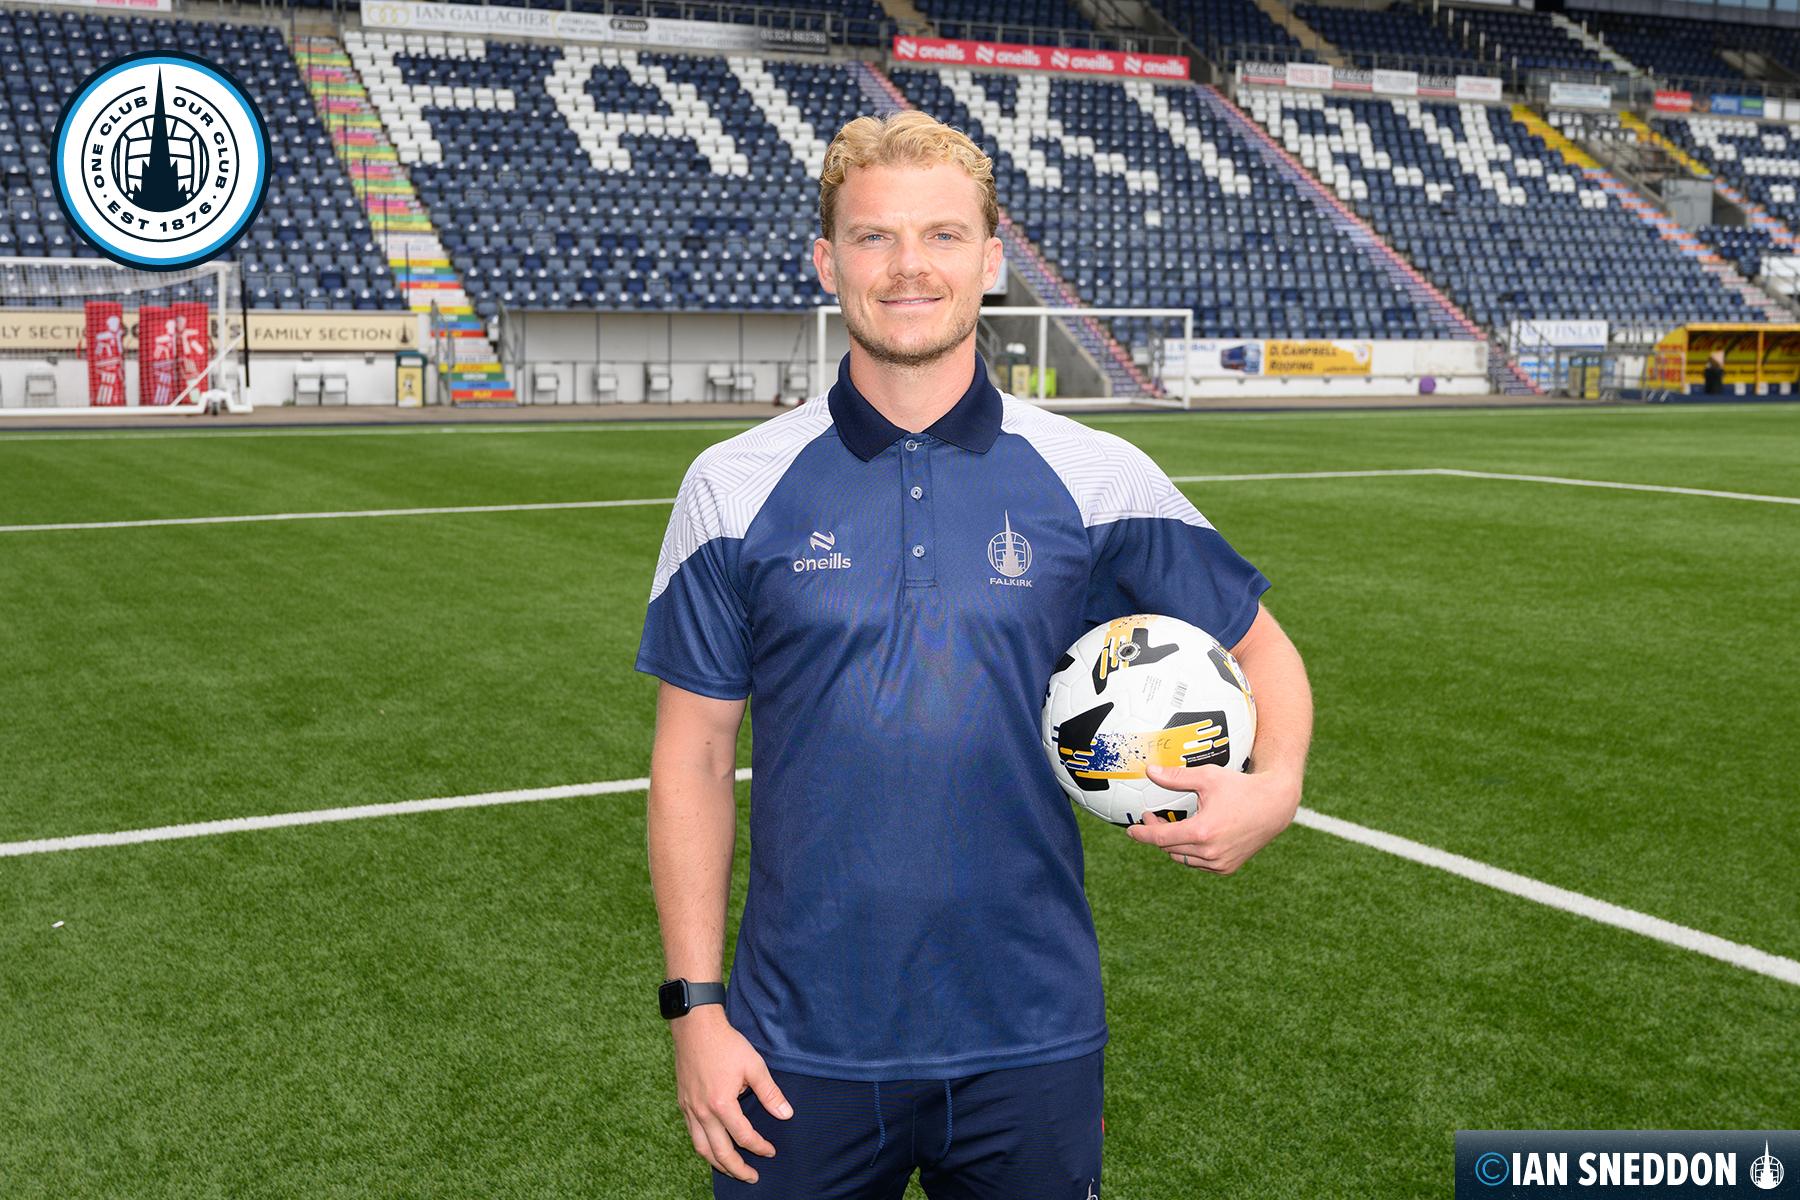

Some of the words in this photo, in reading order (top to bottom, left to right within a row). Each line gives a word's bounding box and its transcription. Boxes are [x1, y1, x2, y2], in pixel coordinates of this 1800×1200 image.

[29, 325, 87, 340] SECTI
[254, 327, 312, 341] FAMILY
[319, 327, 392, 341] SECTION
[793, 552, 852, 573] o'neills
[989, 577, 1033, 588] FALKIRK
